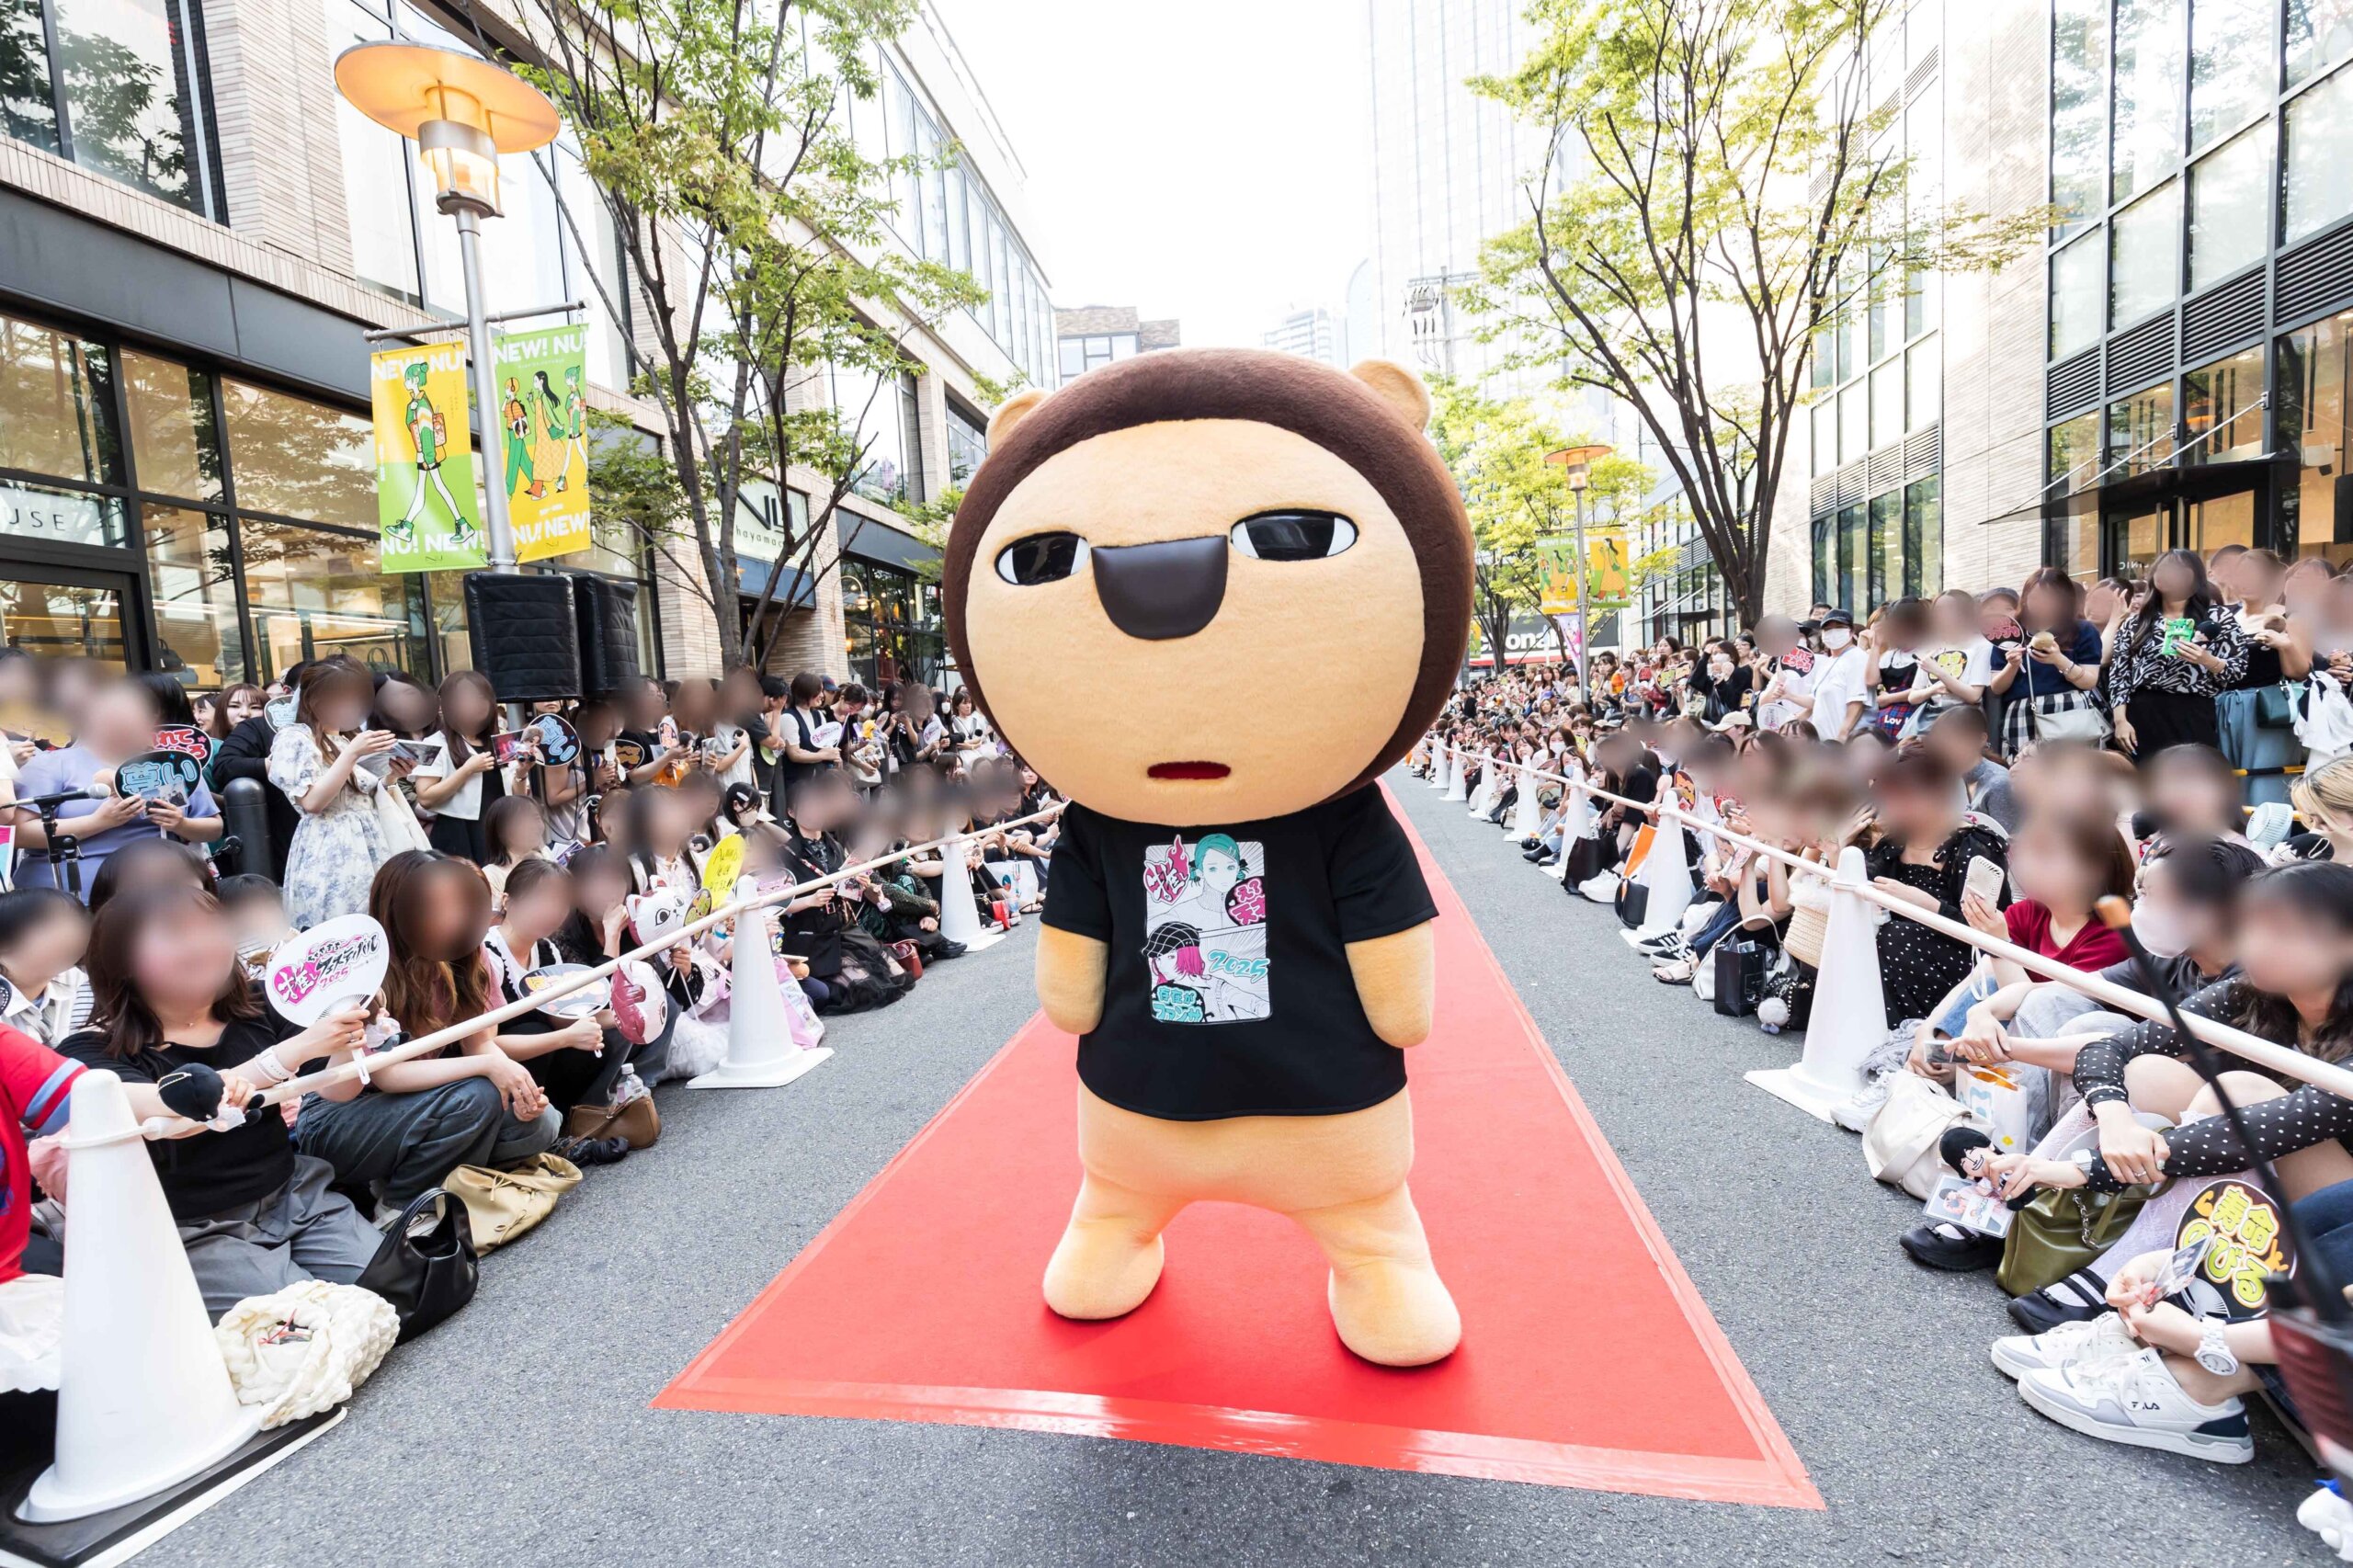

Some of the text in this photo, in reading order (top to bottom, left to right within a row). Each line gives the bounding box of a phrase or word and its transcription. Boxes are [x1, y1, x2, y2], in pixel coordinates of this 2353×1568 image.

[429, 351, 466, 373] NU!
[494, 330, 587, 365] NEW! NU!
[319, 966, 349, 989] 2025
[1209, 950, 1268, 982] 2025
[2211, 1186, 2279, 1255] 寿命
